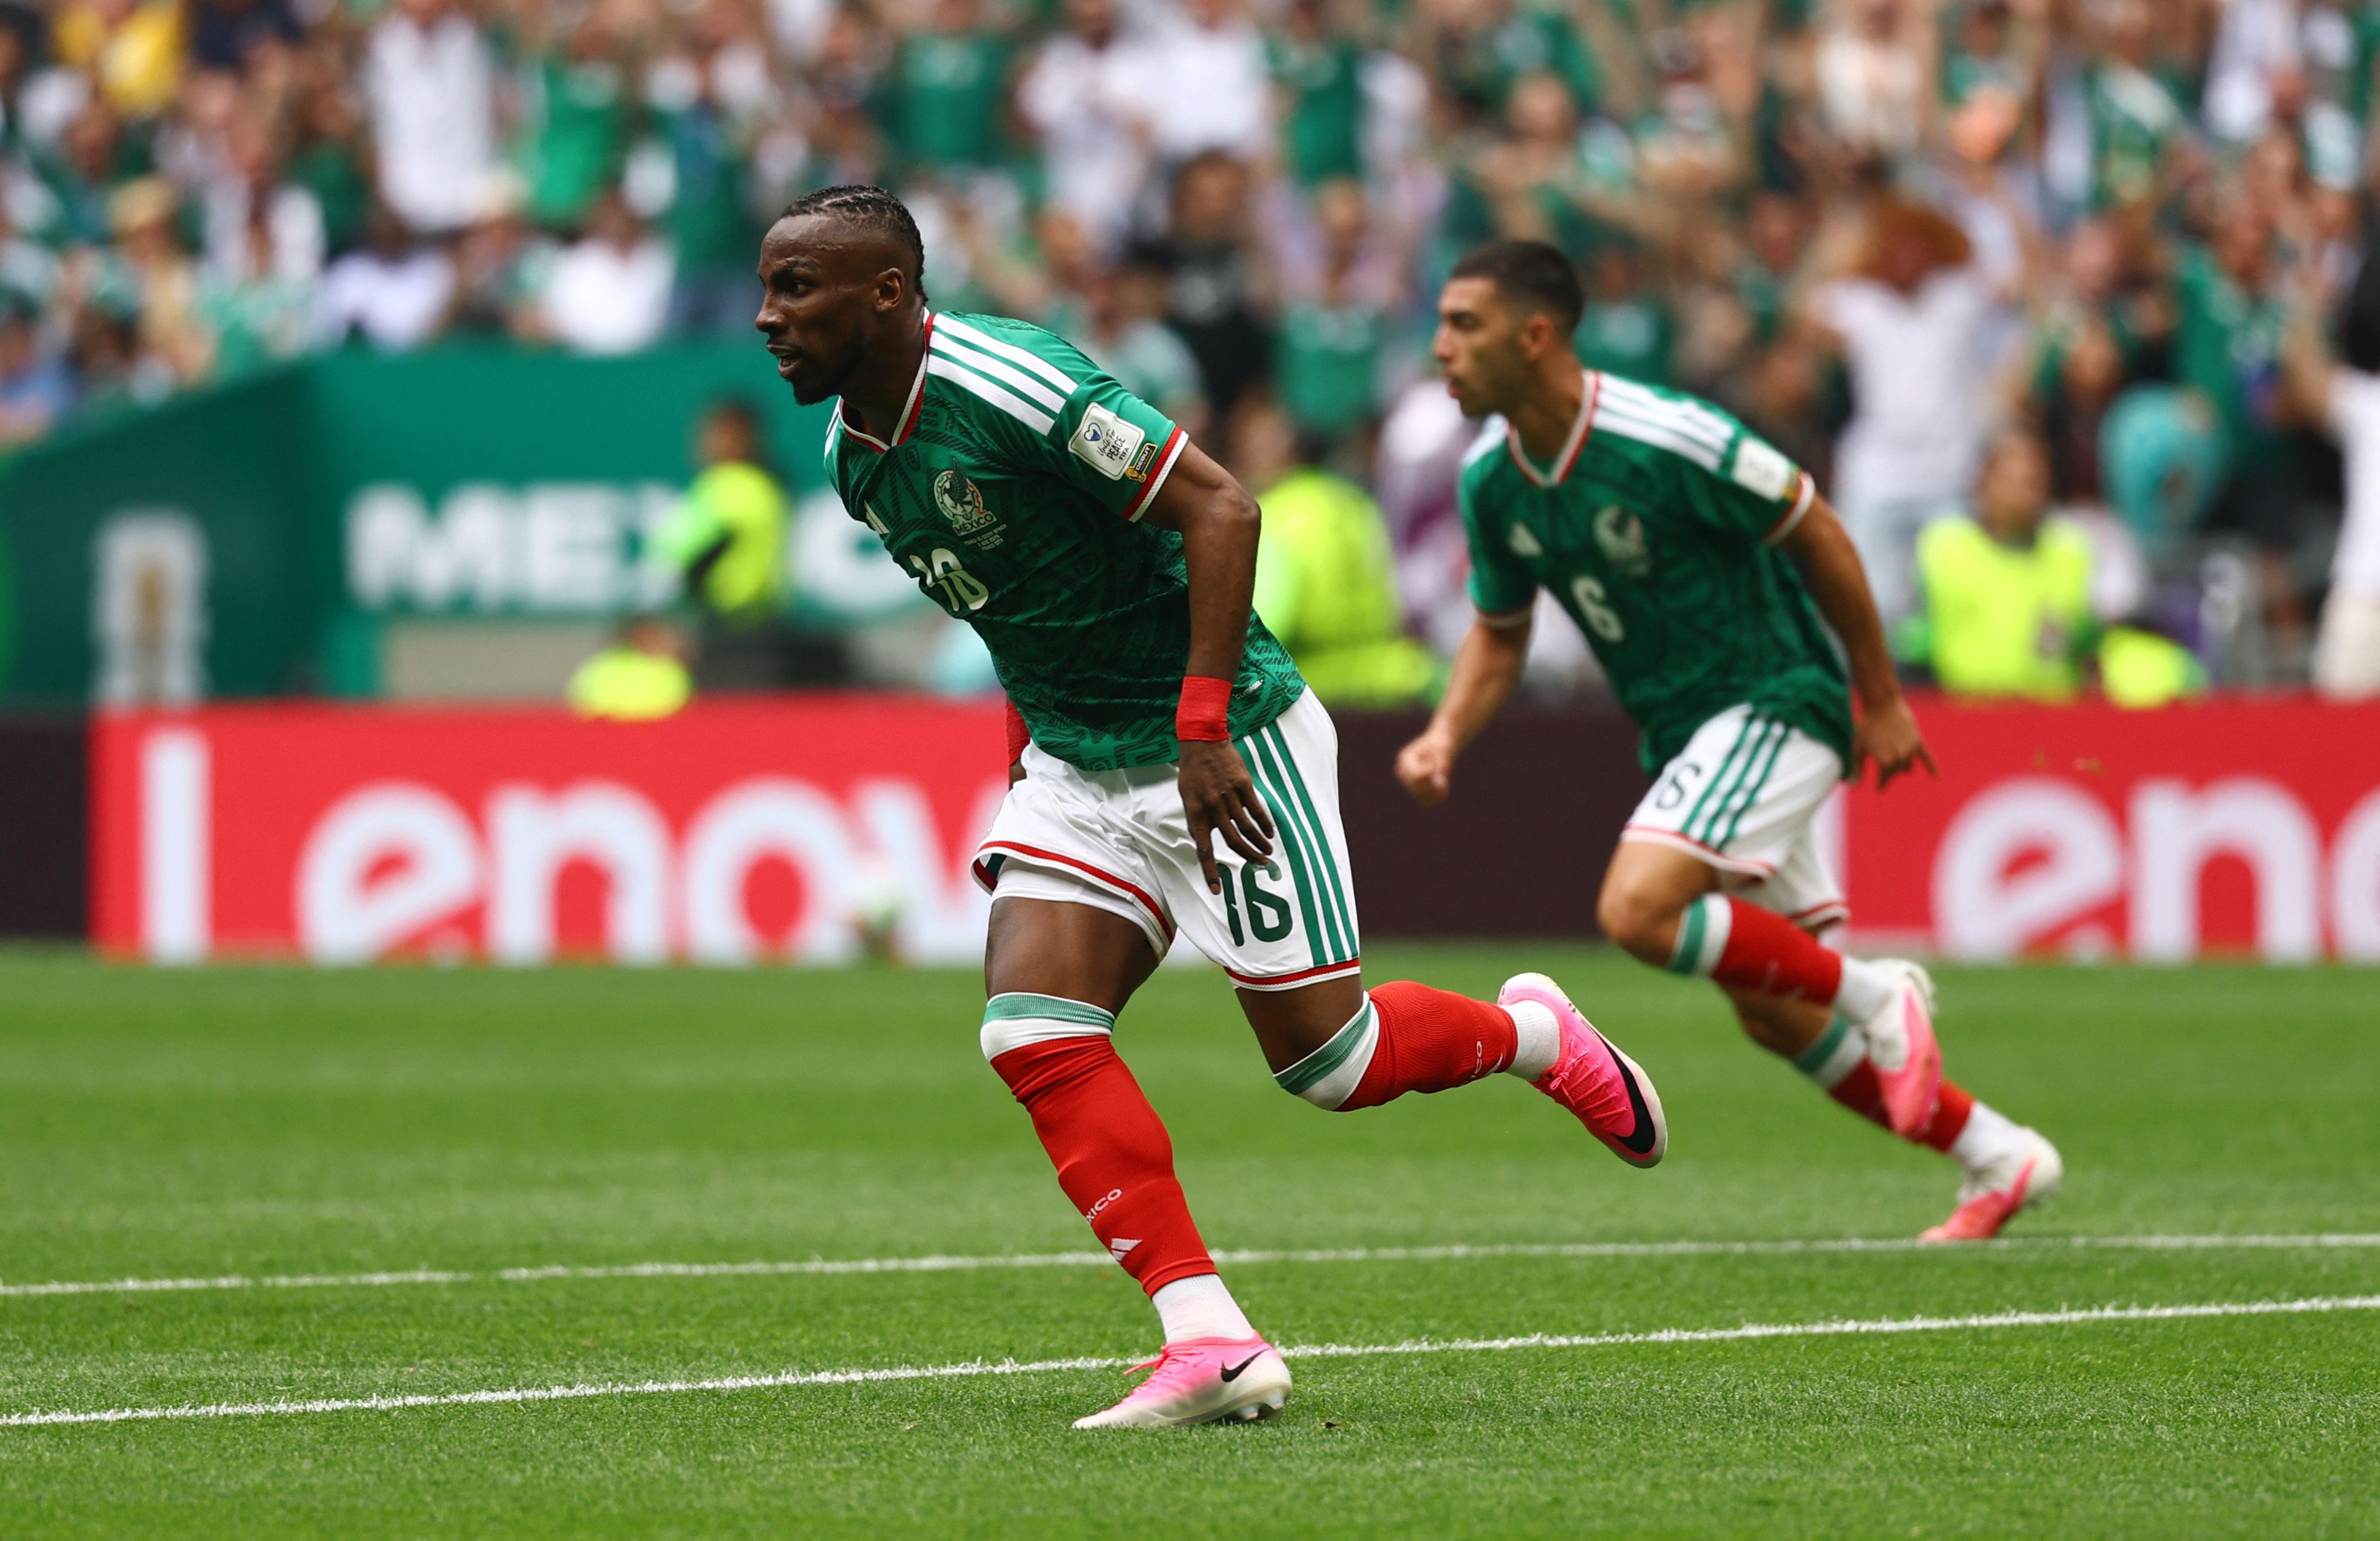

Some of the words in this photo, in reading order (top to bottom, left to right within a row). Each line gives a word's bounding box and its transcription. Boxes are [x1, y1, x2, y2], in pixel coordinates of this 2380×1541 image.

[1097, 438, 1111, 457] Unite
[1106, 428, 1115, 440] For
[1106, 436, 1126, 461] PEACE
[1119, 447, 1130, 460] FIFA
[1136, 447, 1151, 471] DEBUT
[1573, 574, 1625, 644] 6
[140, 726, 1014, 965] Lenov
[1217, 857, 1293, 947] 16
